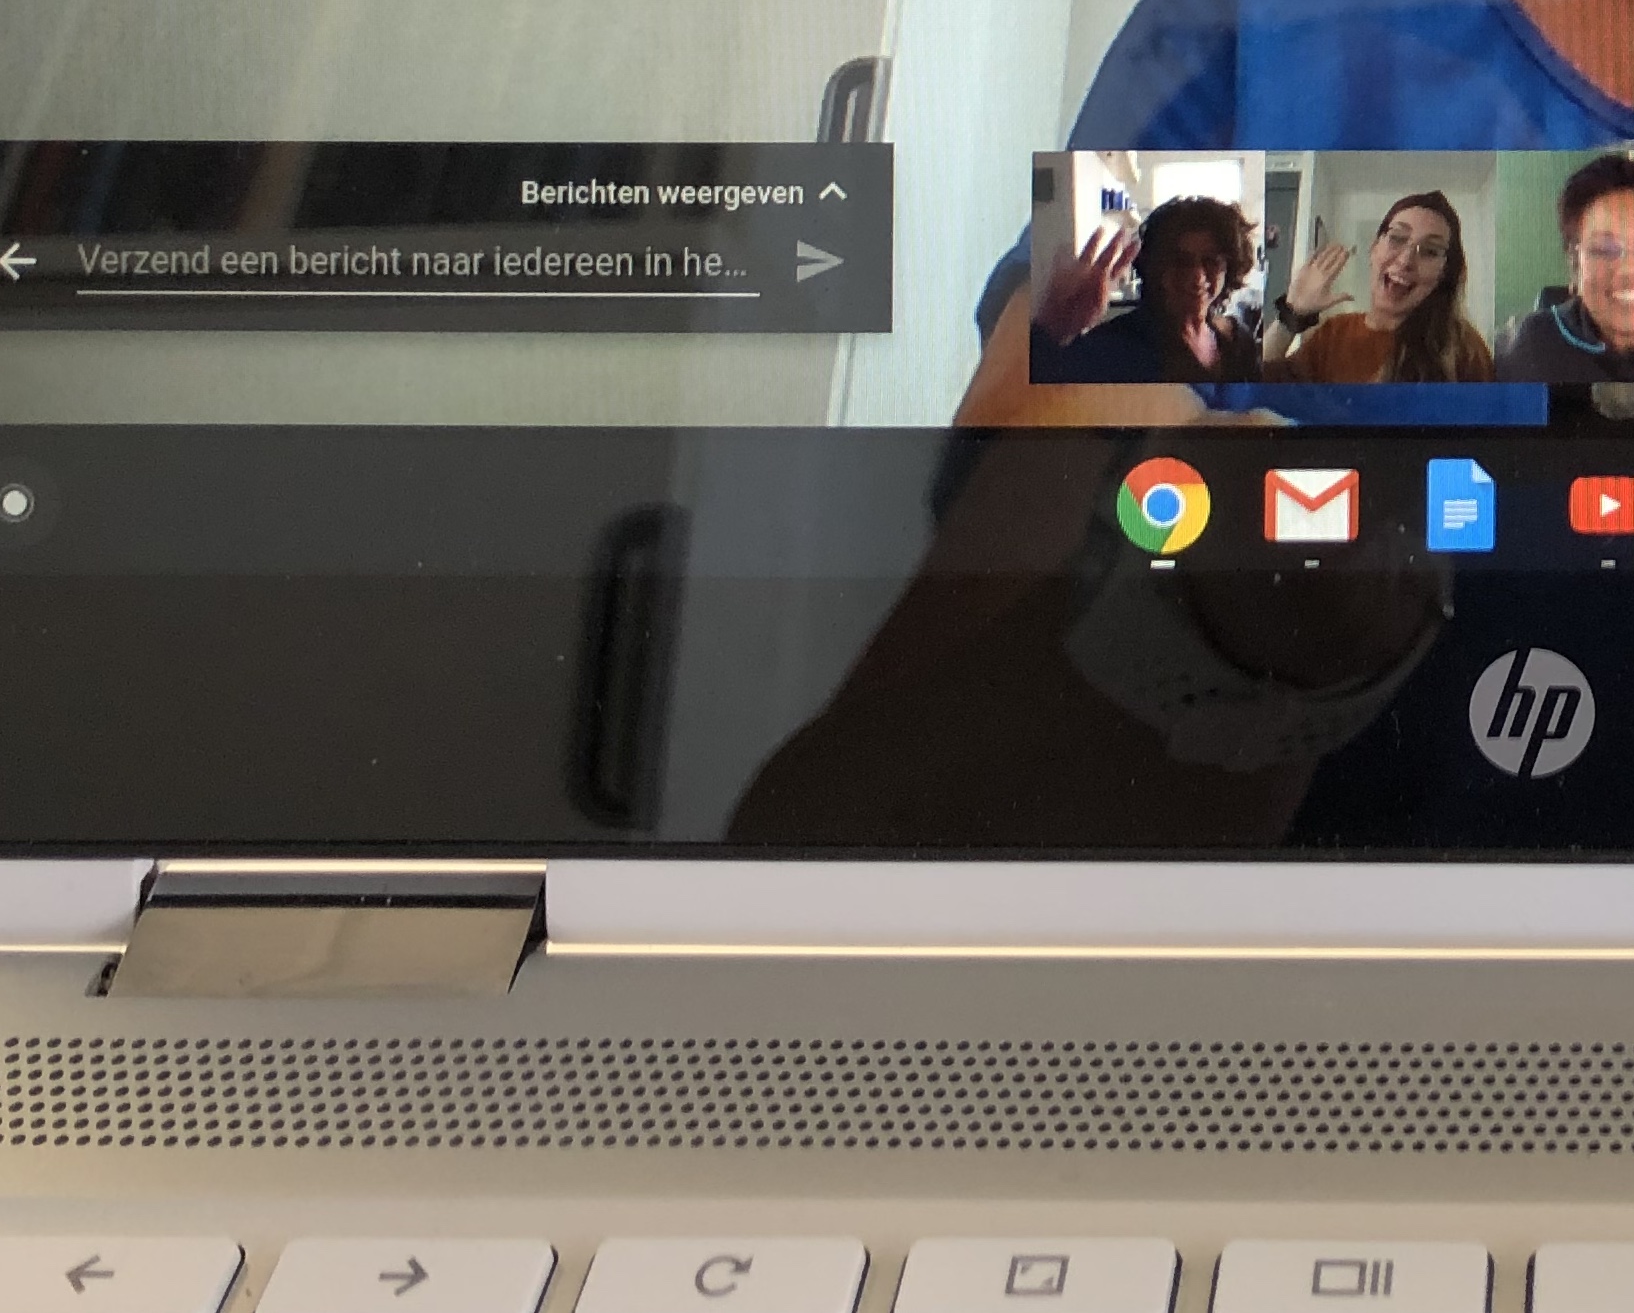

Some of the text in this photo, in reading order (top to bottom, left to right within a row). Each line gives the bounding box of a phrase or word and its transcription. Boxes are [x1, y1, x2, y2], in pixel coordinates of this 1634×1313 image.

[520, 179, 804, 211] Berichten weergeven
[77, 243, 210, 276] Verzend
[221, 251, 278, 276] een
[289, 244, 402, 276] bericht
[412, 252, 484, 277] naar
[494, 246, 633, 277] iedereen
[644, 246, 672, 277] in
[1484, 648, 1584, 779] hp
